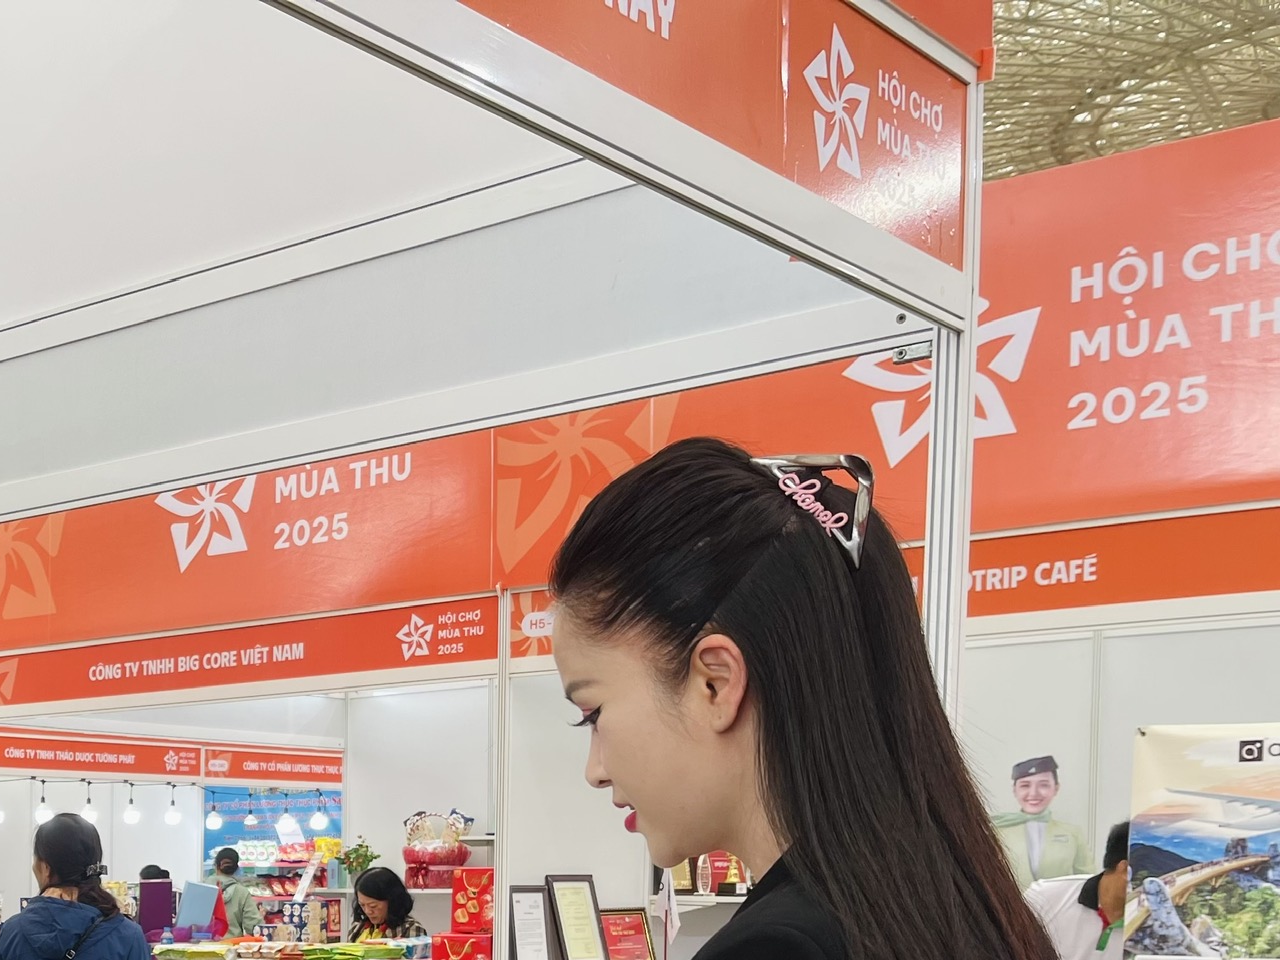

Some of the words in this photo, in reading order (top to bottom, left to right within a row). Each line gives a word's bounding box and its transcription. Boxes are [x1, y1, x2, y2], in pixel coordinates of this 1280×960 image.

[878, 68, 906, 114] HỘI
[909, 91, 943, 139] CHỢ
[877, 117, 912, 161] MÙA
[1070, 246, 1164, 305] HỘI
[1069, 309, 1192, 368] MÙA
[1209, 297, 1280, 343] TH
[1066, 374, 1209, 431] 2025
[275, 464, 340, 504] MÙA
[349, 452, 412, 490] THU
[273, 512, 349, 550] 2025
[1034, 553, 1098, 587] CAFÉ
[437, 627, 461, 641] MÙA
[463, 625, 485, 637] THU
[438, 611, 456, 627] HỘI
[458, 609, 481, 625] CHỢ
[529, 617, 553, 631] H5-
[88, 662, 122, 682] CÔNG
[124, 662, 140, 678] TY
[141, 658, 175, 677] TNHH
[177, 654, 200, 673] BIG
[202, 650, 238, 670] CORE
[240, 643, 270, 667] VIỆT
[272, 642, 305, 662] NAM
[437, 642, 464, 656] 2025
